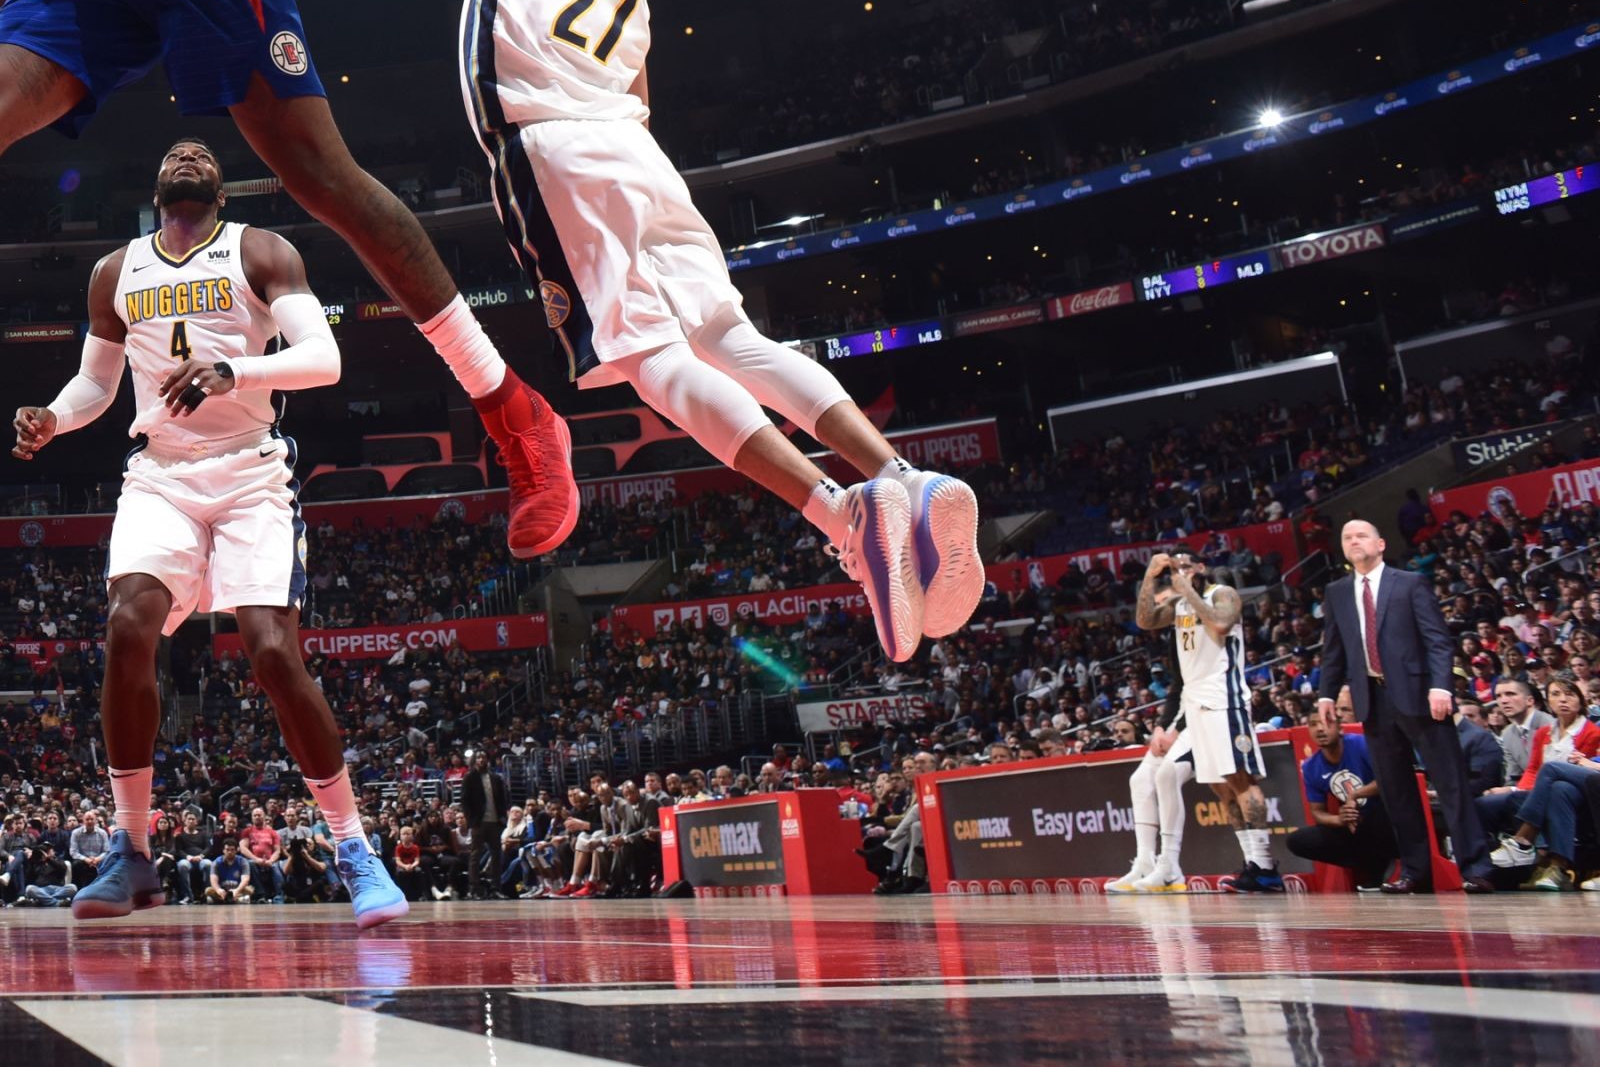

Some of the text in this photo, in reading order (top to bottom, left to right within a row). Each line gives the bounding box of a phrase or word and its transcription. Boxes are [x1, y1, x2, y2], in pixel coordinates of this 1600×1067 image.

[1555, 171, 1565, 185] 3
[1575, 166, 1584, 180] F
[1559, 186, 1568, 199] 2
[1282, 228, 1385, 266] TOYOTA
[1142, 275, 1167, 289] BAL
[1212, 261, 1221, 272] F
[1237, 261, 1264, 279] MLB
[125, 276, 232, 327] NUGGETS
[1144, 285, 1171, 300] NYY
[323, 304, 345, 315] DEN
[962, 308, 1041, 328] SAN MANUEL CASINO
[328, 315, 341, 325] 29
[50, 328, 74, 336] CASINO
[170, 319, 193, 361] 4
[826, 328, 943, 350] TB 3 F MLB
[827, 342, 884, 360] BOS 10
[304, 628, 458, 655] CLIPPERS.COM
[1032, 807, 1105, 842] Easy car
